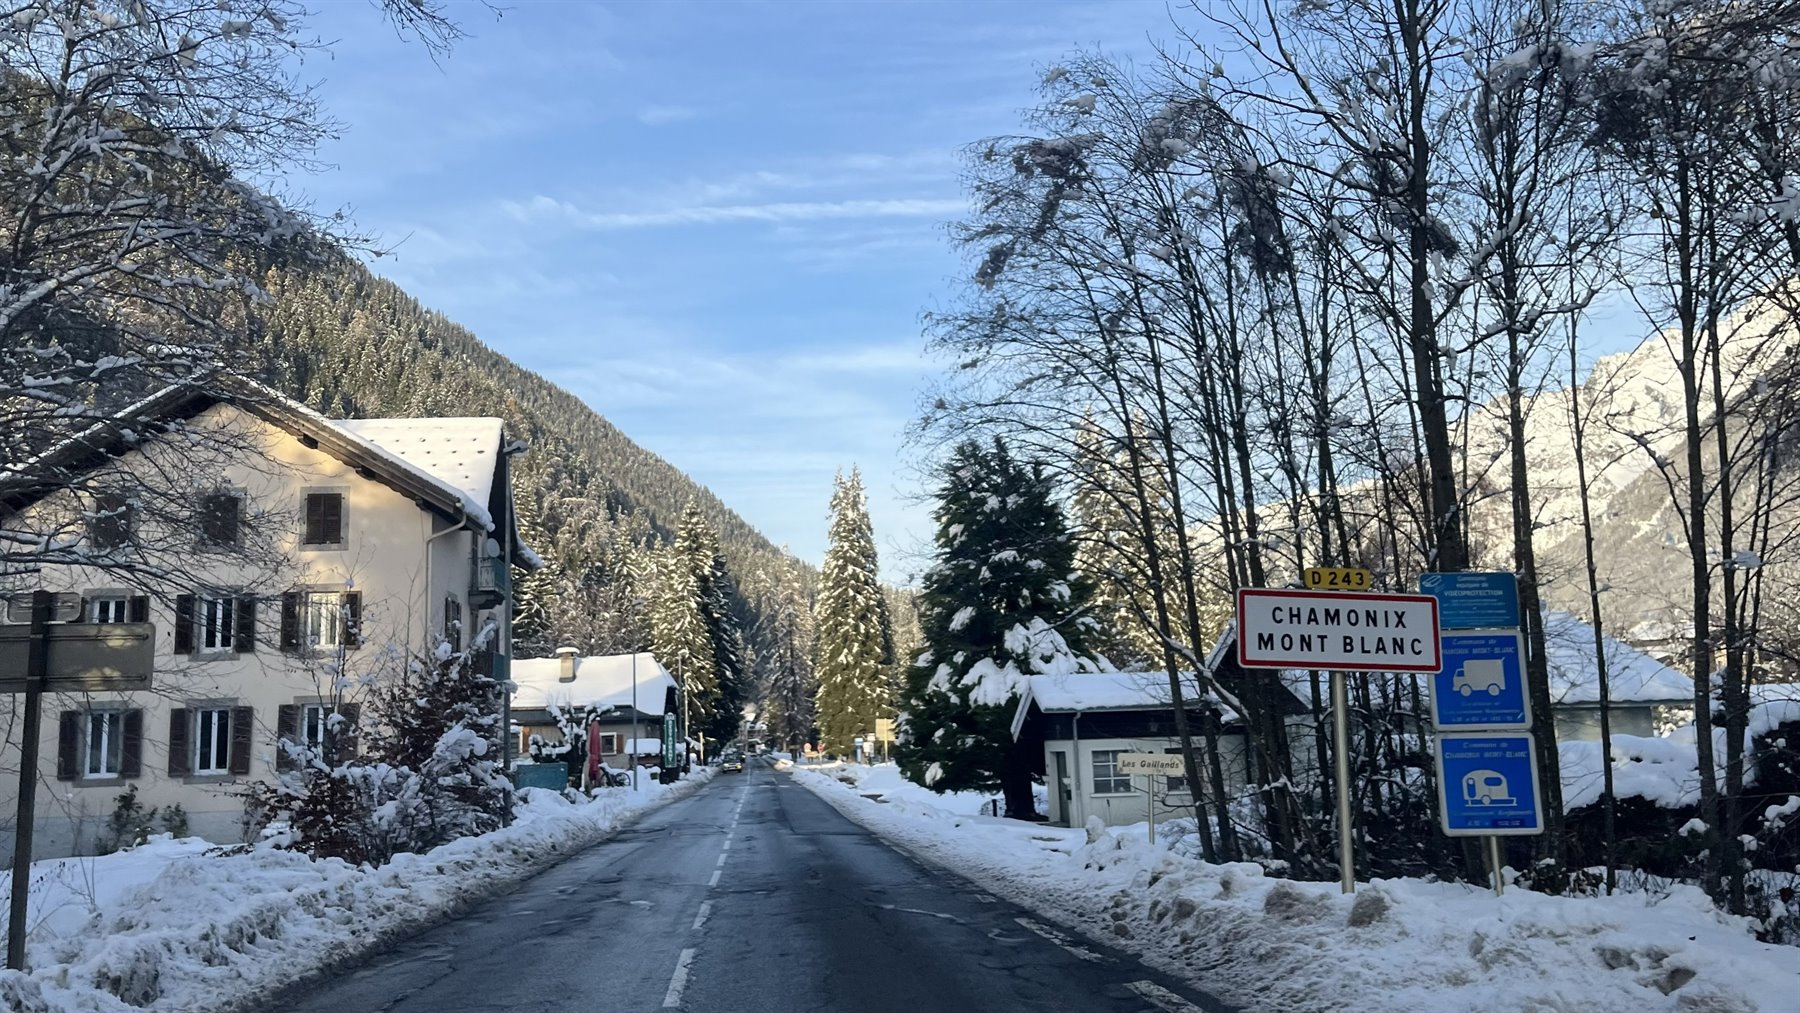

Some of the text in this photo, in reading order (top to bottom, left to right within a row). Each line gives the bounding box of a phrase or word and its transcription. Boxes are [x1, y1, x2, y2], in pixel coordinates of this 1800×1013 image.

[1312, 572, 1364, 586] D 243
[1272, 606, 1407, 629] CHAMONIX
[1258, 632, 1422, 656] MONT BLANC
[1122, 760, 1180, 768] Les Gaillands
